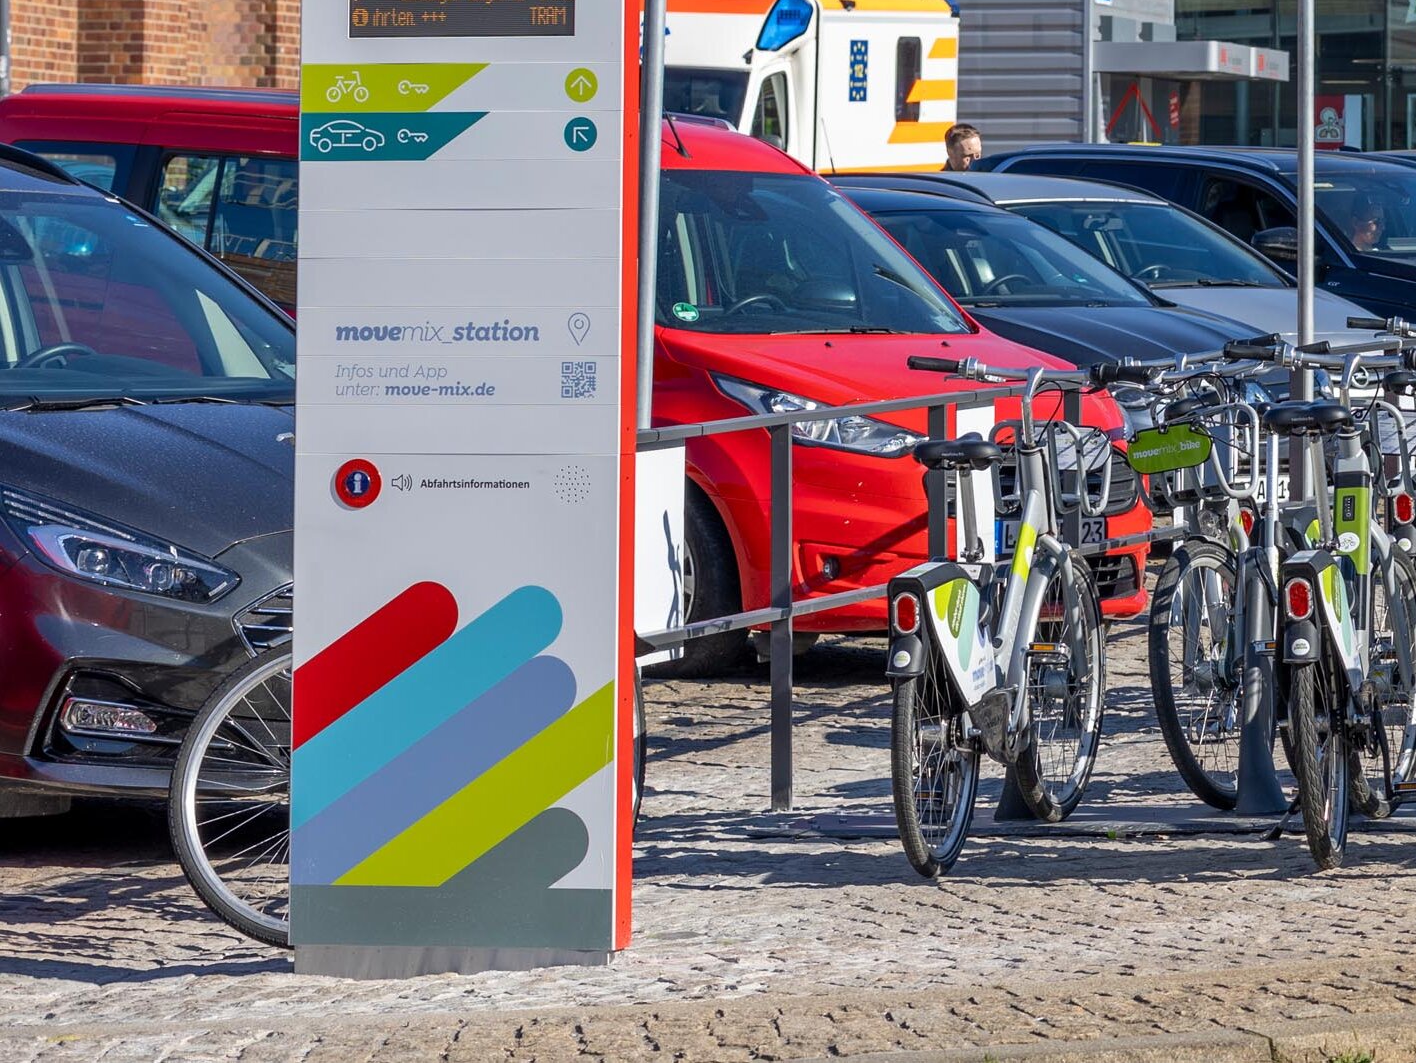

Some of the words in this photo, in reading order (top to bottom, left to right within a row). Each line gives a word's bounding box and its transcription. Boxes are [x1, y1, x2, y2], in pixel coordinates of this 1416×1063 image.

[530, 7, 567, 26] TRAM
[335, 320, 540, 344] movemix_station
[335, 364, 374, 380] Infos
[378, 364, 410, 378] und
[414, 365, 448, 380] App
[335, 382, 379, 396] unter:
[385, 381, 496, 397] move-mix.de
[420, 479, 530, 489] Abfahrtsinformationen
